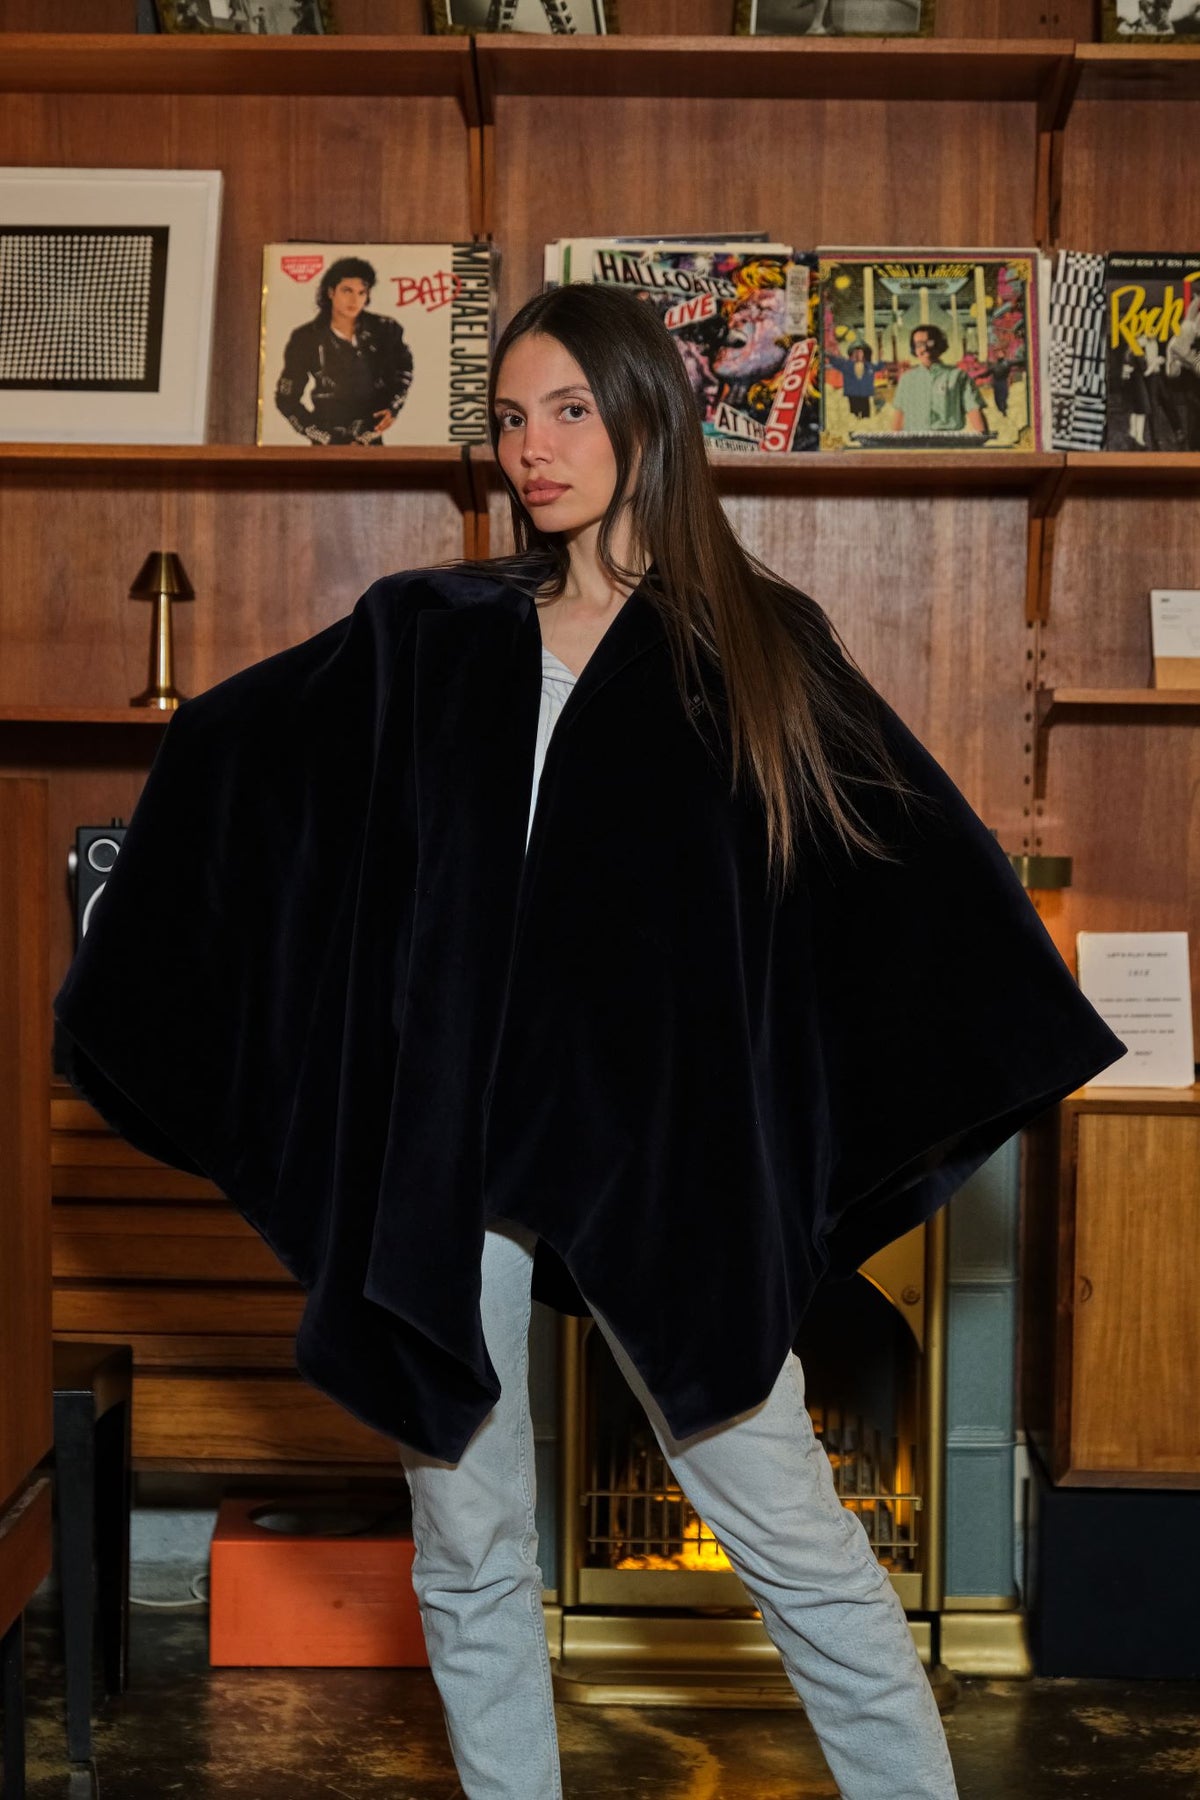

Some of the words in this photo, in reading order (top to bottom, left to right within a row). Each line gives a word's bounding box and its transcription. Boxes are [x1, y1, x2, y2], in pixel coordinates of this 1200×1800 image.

[390, 269, 462, 312] BAD
[450, 243, 489, 344] MICHAEL
[667, 291, 713, 328] LIVE
[1111, 284, 1184, 356] Rock
[448, 347, 488, 446] JACKSON
[718, 404, 738, 432] AT
[764, 341, 809, 451] APOLLO
